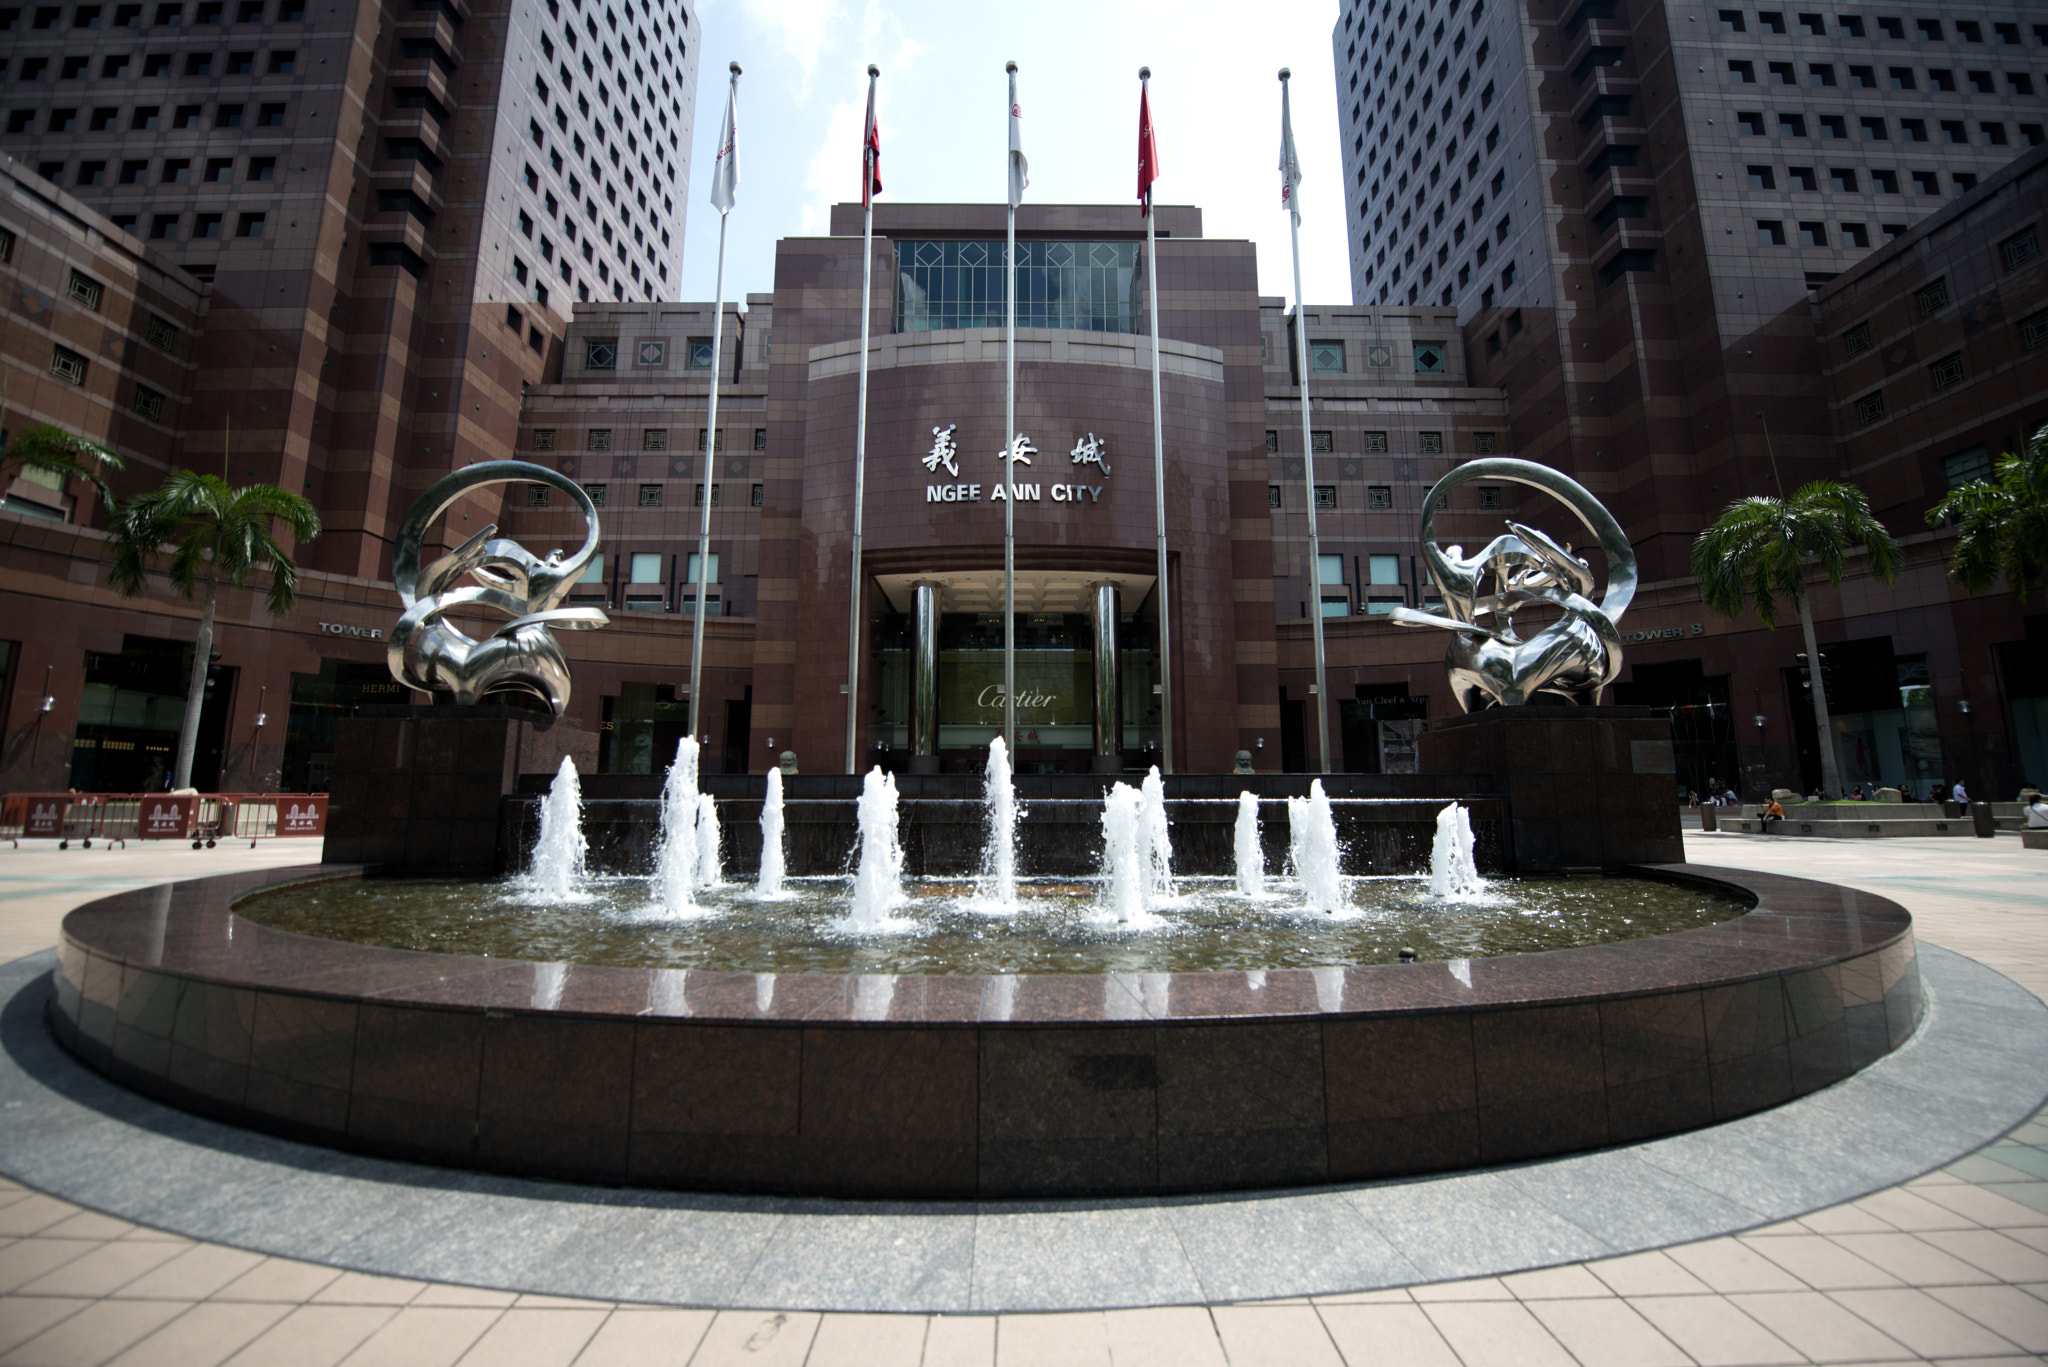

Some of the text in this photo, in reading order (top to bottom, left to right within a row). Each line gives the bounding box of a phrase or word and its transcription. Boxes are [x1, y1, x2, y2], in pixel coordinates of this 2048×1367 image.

[927, 483, 1103, 503] NGEE ANN CITY
[319, 622, 382, 639] TOWER
[1622, 623, 1703, 642] TOWER B
